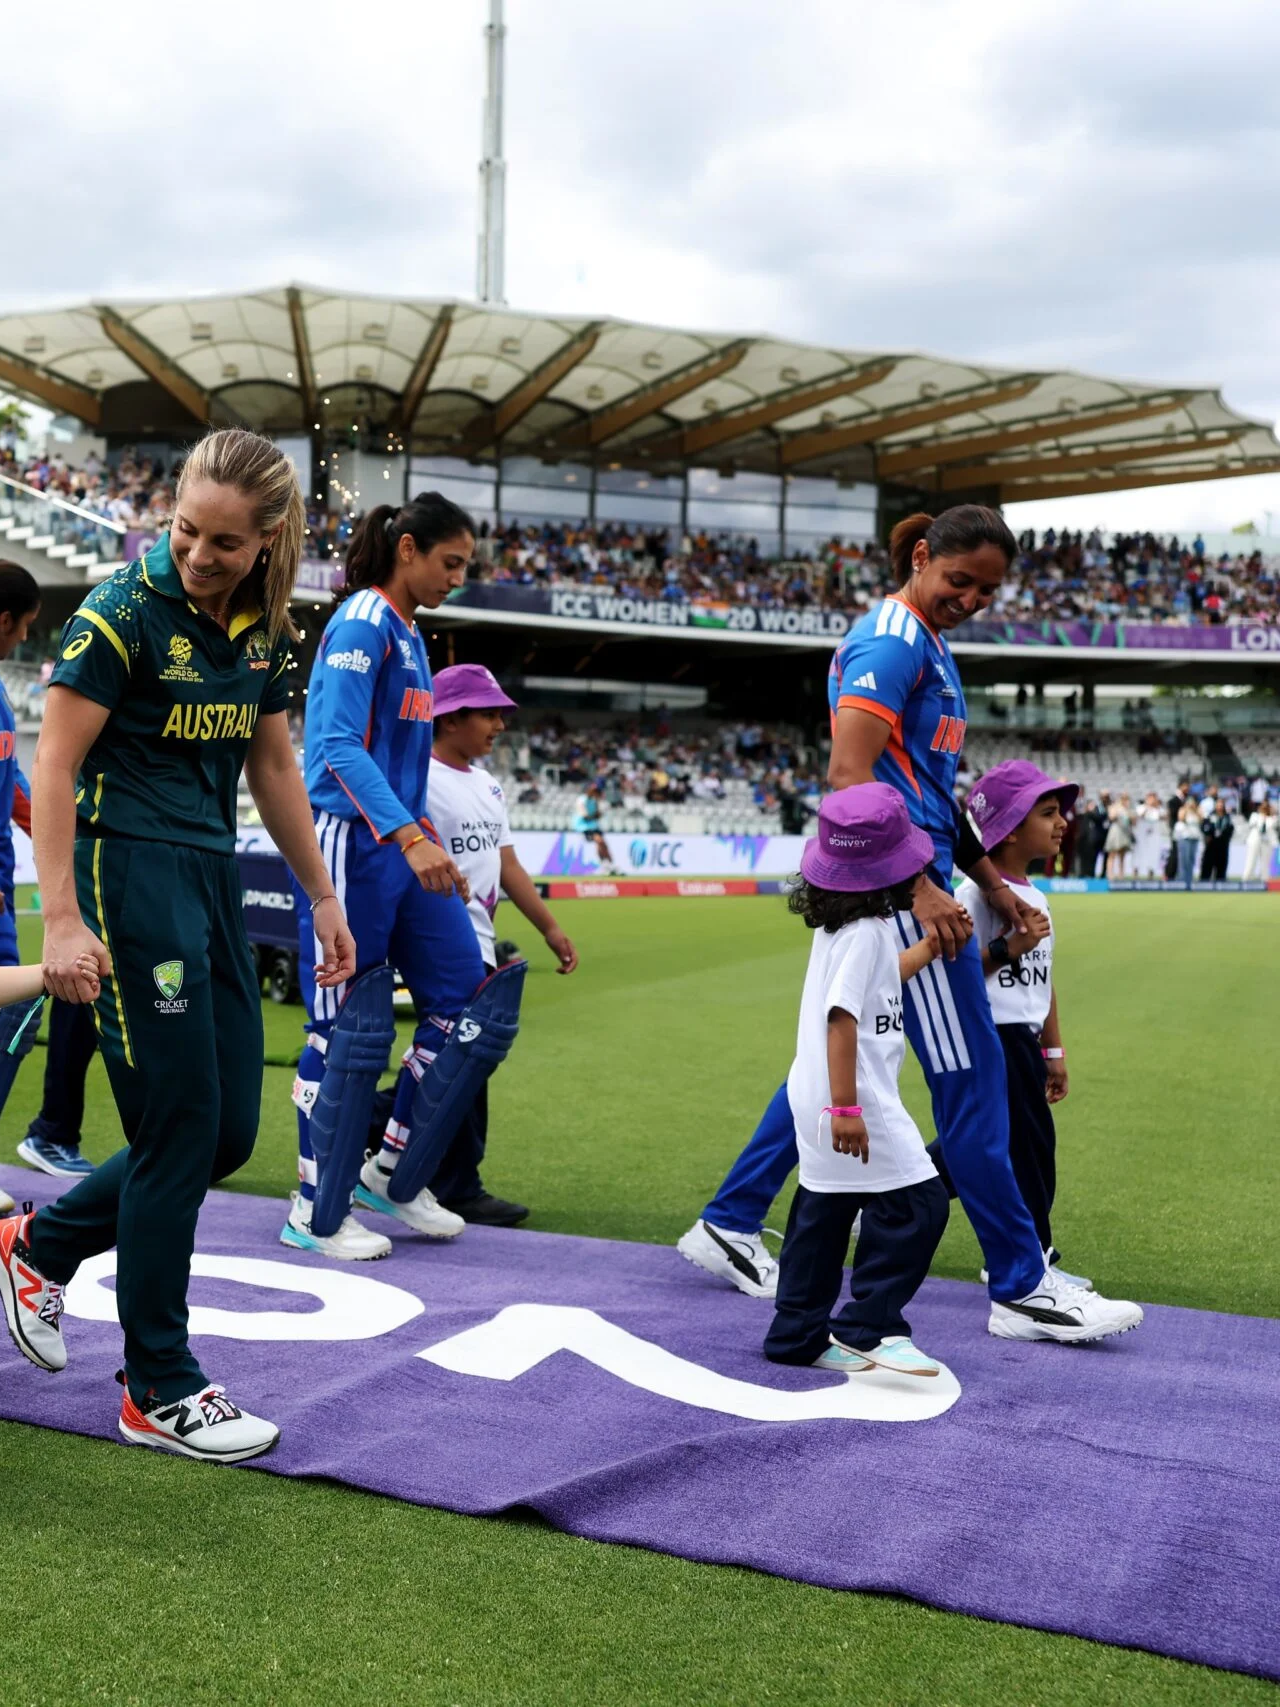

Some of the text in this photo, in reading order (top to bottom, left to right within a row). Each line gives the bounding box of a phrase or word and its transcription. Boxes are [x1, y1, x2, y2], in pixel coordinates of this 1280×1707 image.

[551, 593, 592, 617] ICC
[727, 606, 756, 630] 20
[760, 609, 849, 636] WORLD
[326, 649, 371, 668] apollo
[163, 668, 186, 677] WORLD
[649, 842, 684, 868] ICC
[154, 1000, 189, 1009] CRICKET
